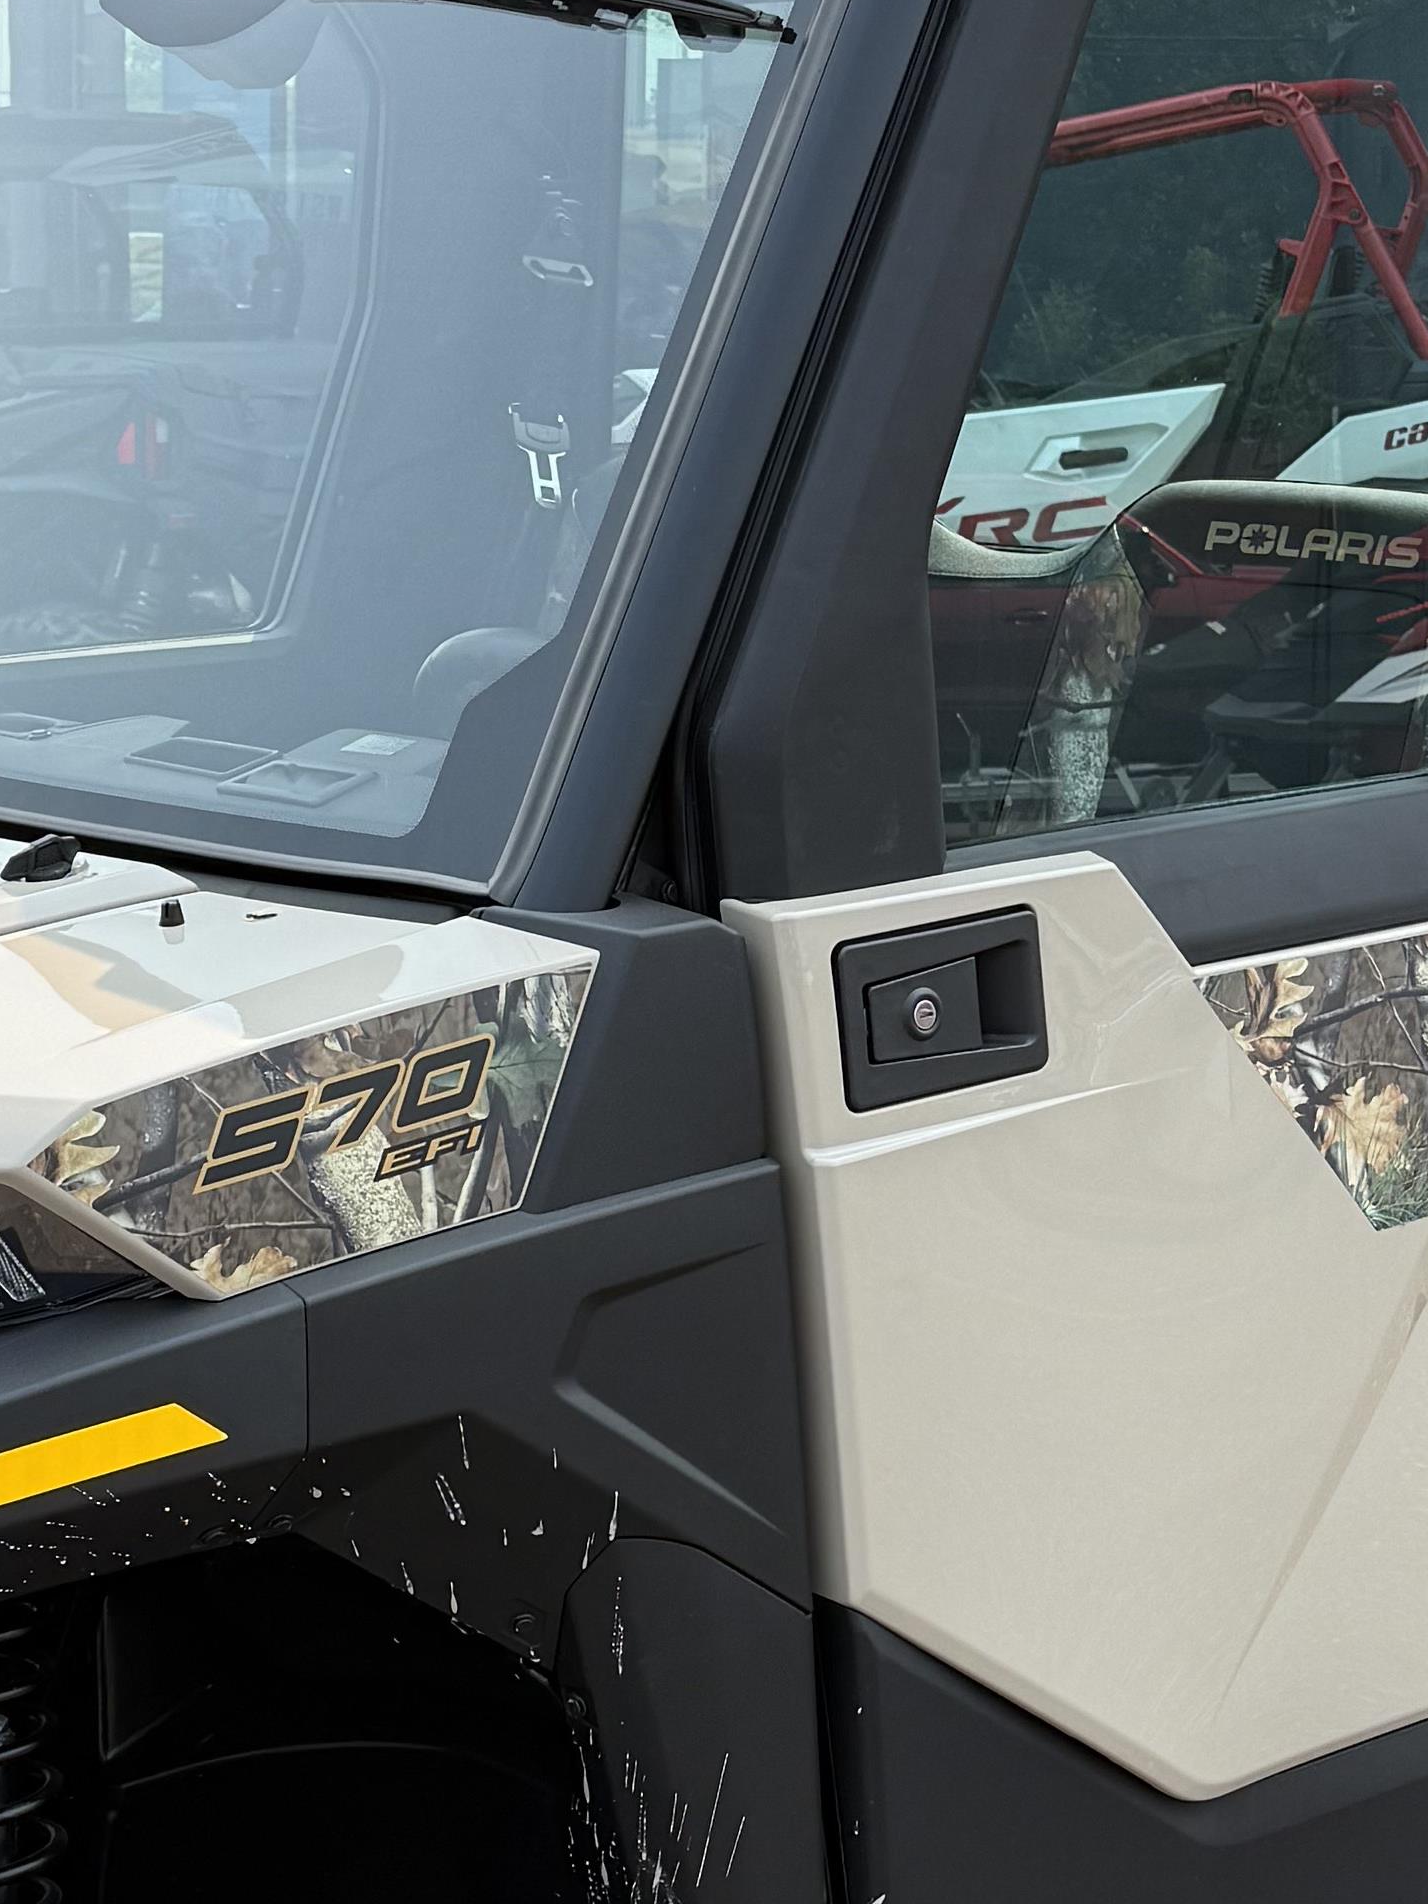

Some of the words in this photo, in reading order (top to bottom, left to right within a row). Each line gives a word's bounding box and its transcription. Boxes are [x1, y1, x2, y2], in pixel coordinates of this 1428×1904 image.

[1204, 520, 1422, 569] POLARIS
[193, 1033, 496, 1195] 570
[374, 1124, 486, 1182] EFI
